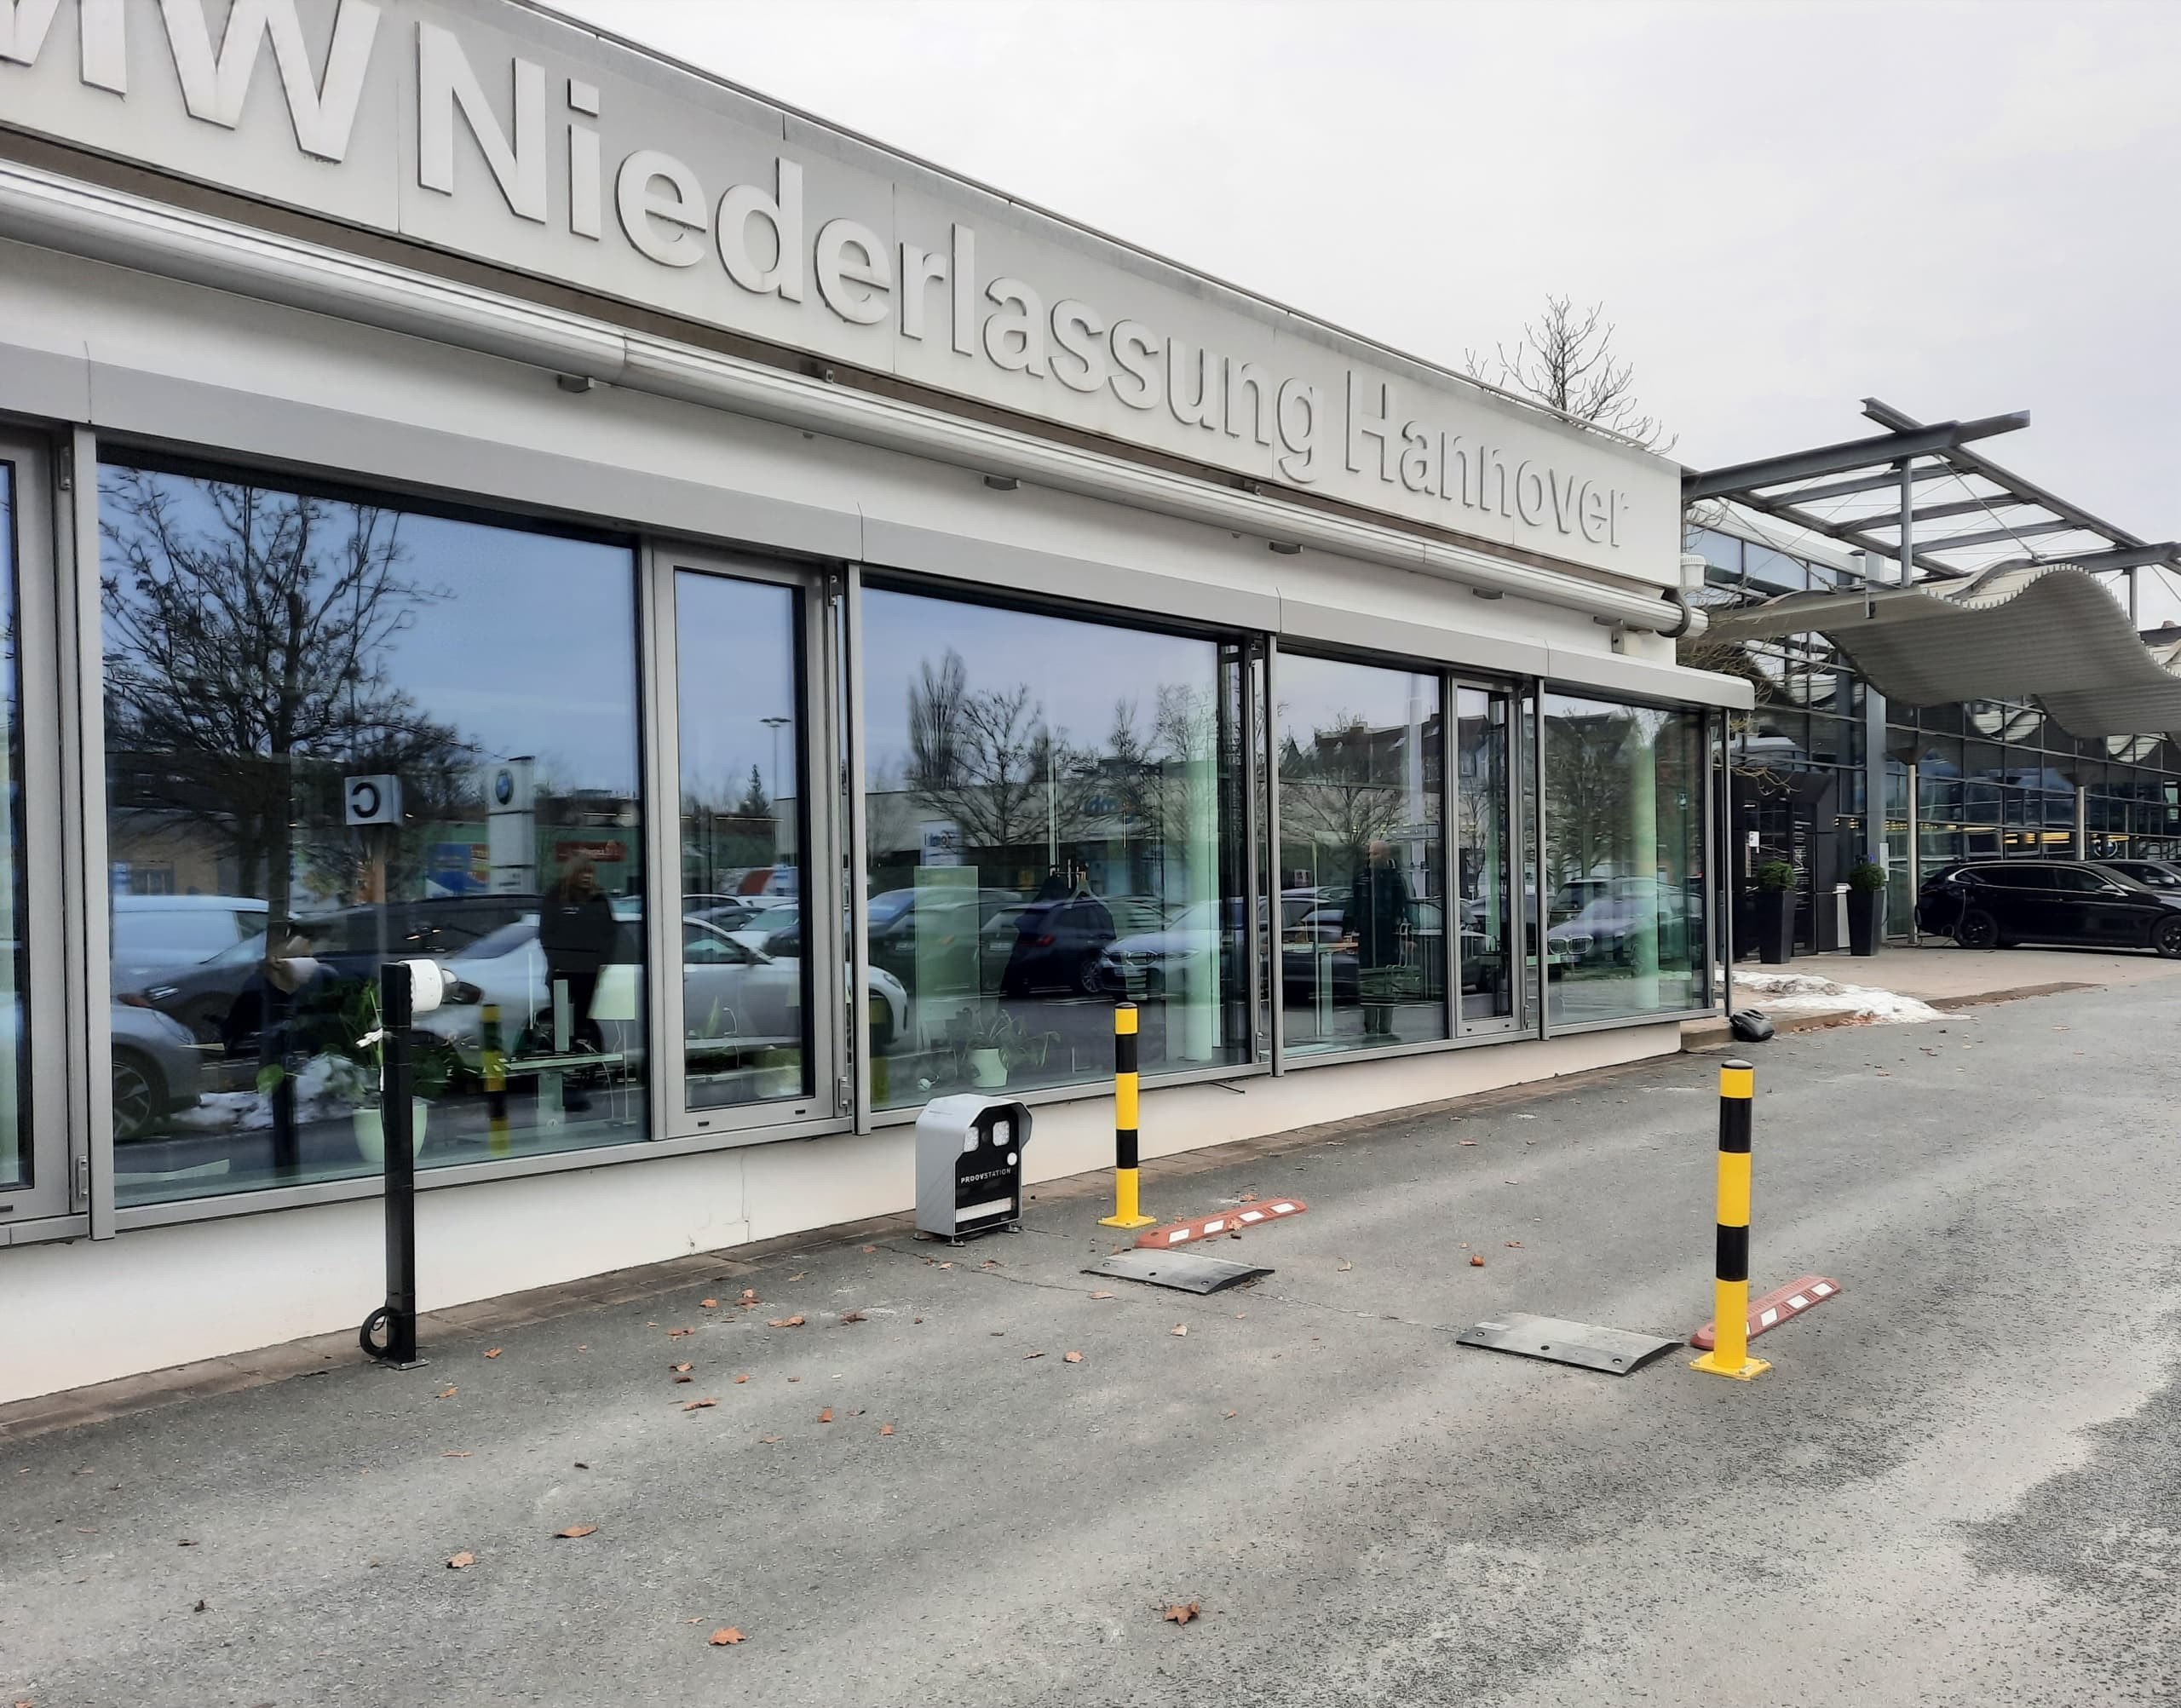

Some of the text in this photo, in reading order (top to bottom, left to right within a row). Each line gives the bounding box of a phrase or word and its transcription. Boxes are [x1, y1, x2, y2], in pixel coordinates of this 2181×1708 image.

[414, 20, 1324, 484] Niederlassung
[1344, 369, 1629, 547] Hannover
[960, 1168, 1011, 1184] PROOVSTATION
